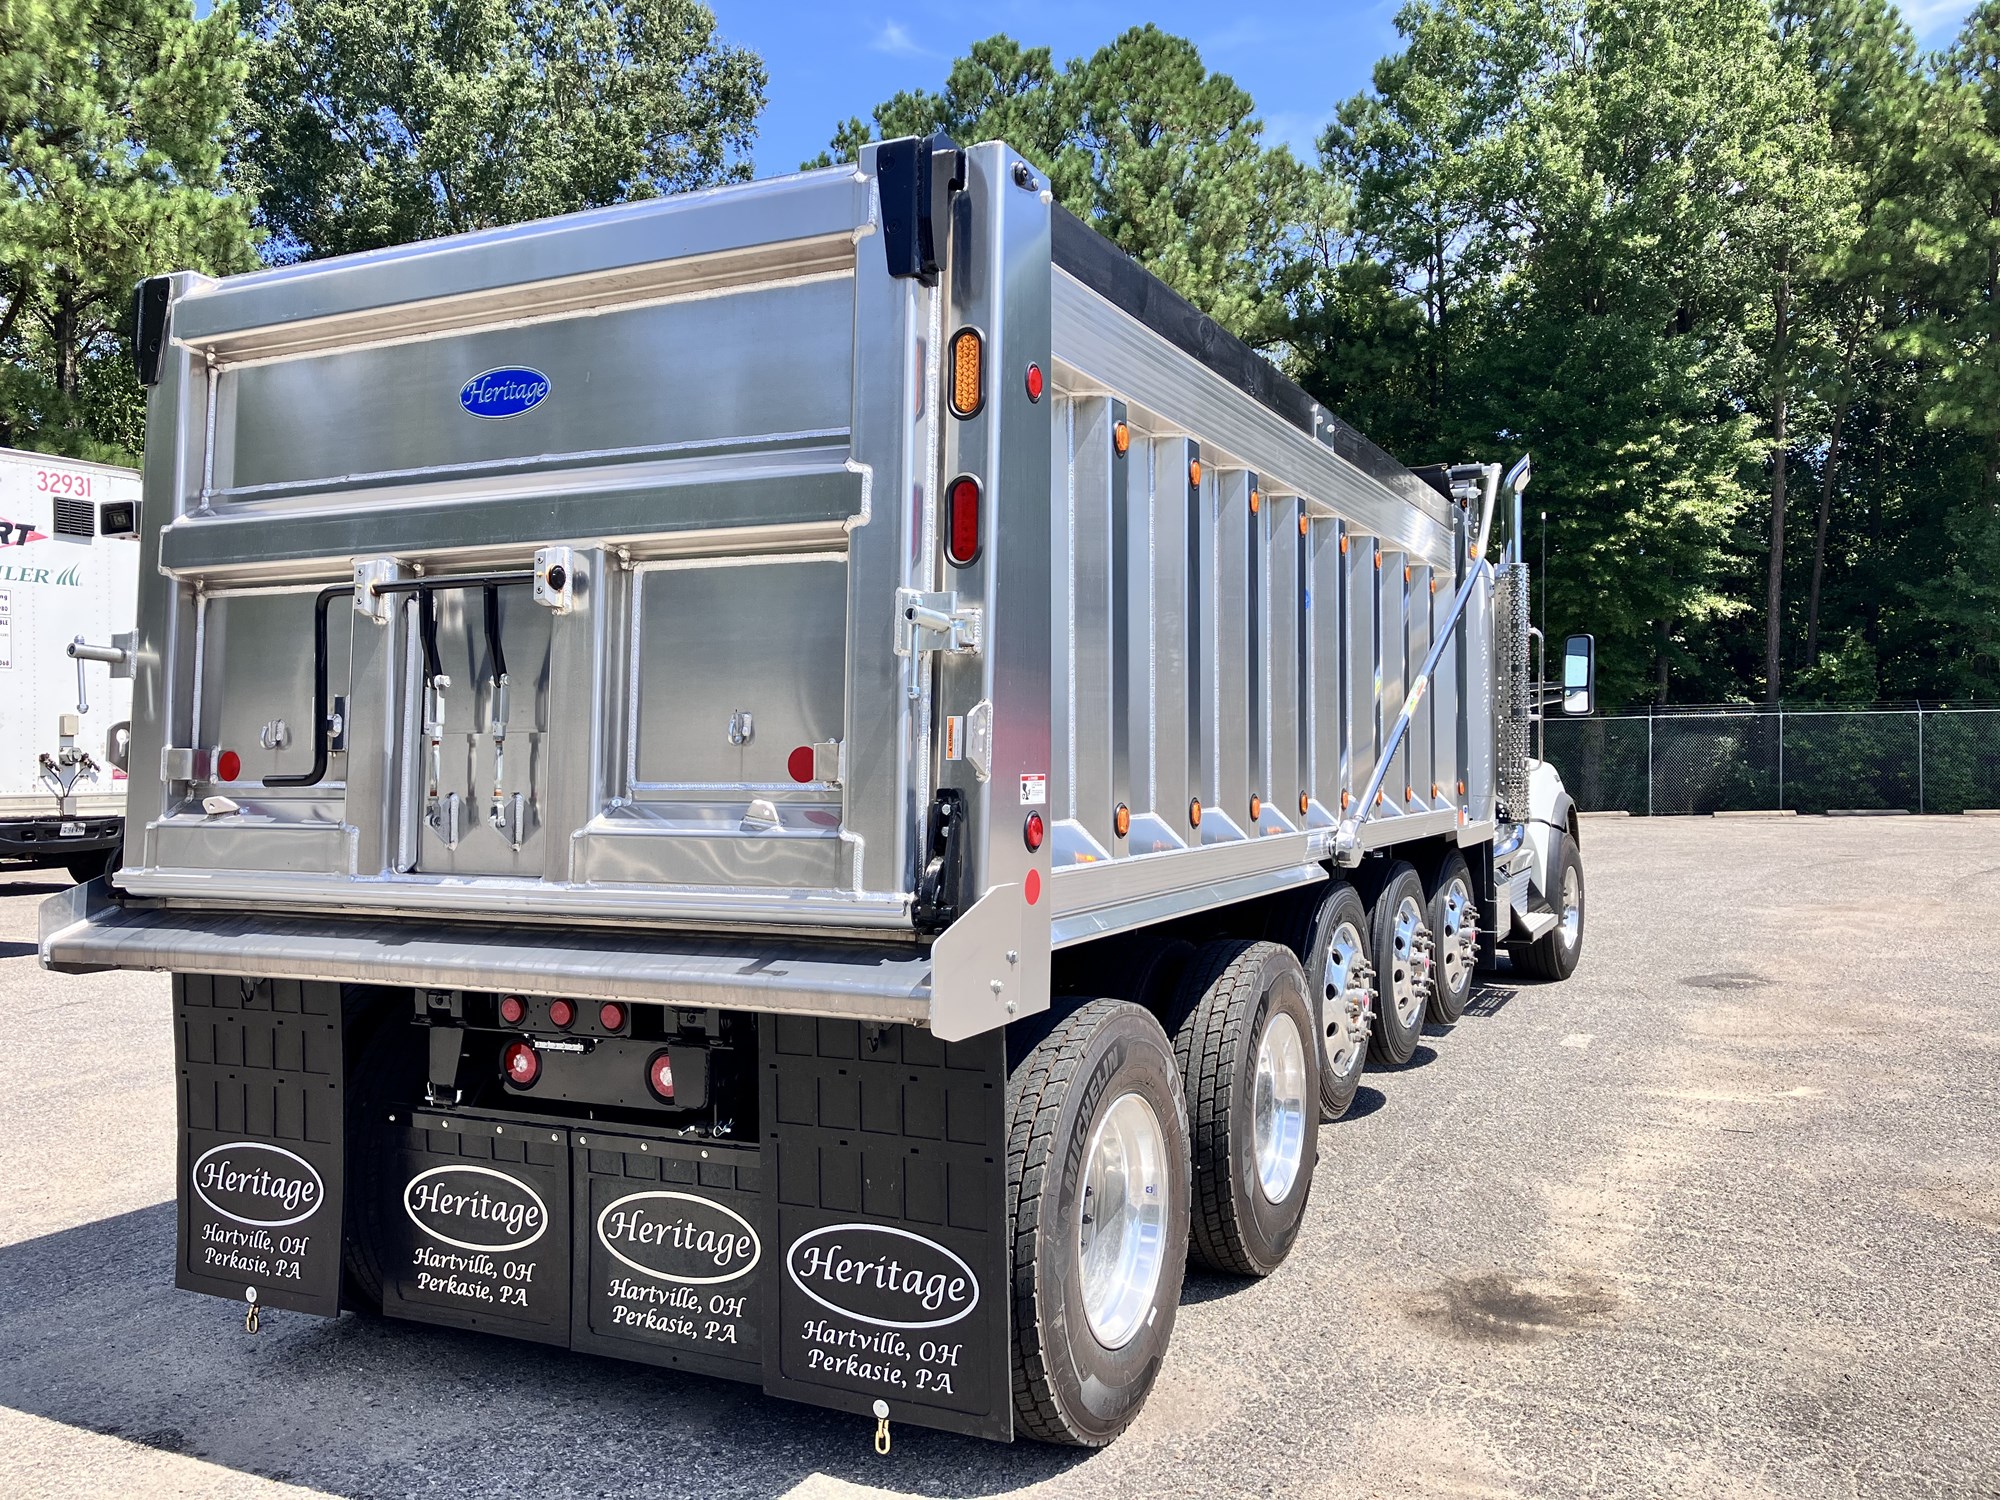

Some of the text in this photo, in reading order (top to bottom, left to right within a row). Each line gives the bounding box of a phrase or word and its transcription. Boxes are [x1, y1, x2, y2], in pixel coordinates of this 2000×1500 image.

[463, 376, 546, 406] Heritage
[37, 471, 91, 497] 32931
[1064, 1046, 1119, 1196] MICHELIN
[200, 1160, 315, 1211] Heritage
[412, 1182, 539, 1235] Heritage
[201, 1223, 310, 1256] Hartville, OH
[607, 1209, 751, 1266] Heritage
[204, 1247, 302, 1280] Perkasie, PA
[412, 1247, 537, 1283] Hartville, OH
[799, 1245, 966, 1310] Heritage
[417, 1272, 529, 1307] Perkasie, PA
[607, 1278, 747, 1318] Hartville, OH
[612, 1305, 738, 1344] Perkasie, PA
[801, 1320, 963, 1367] Hartville, OH
[807, 1348, 954, 1395] Perkasie, PA
